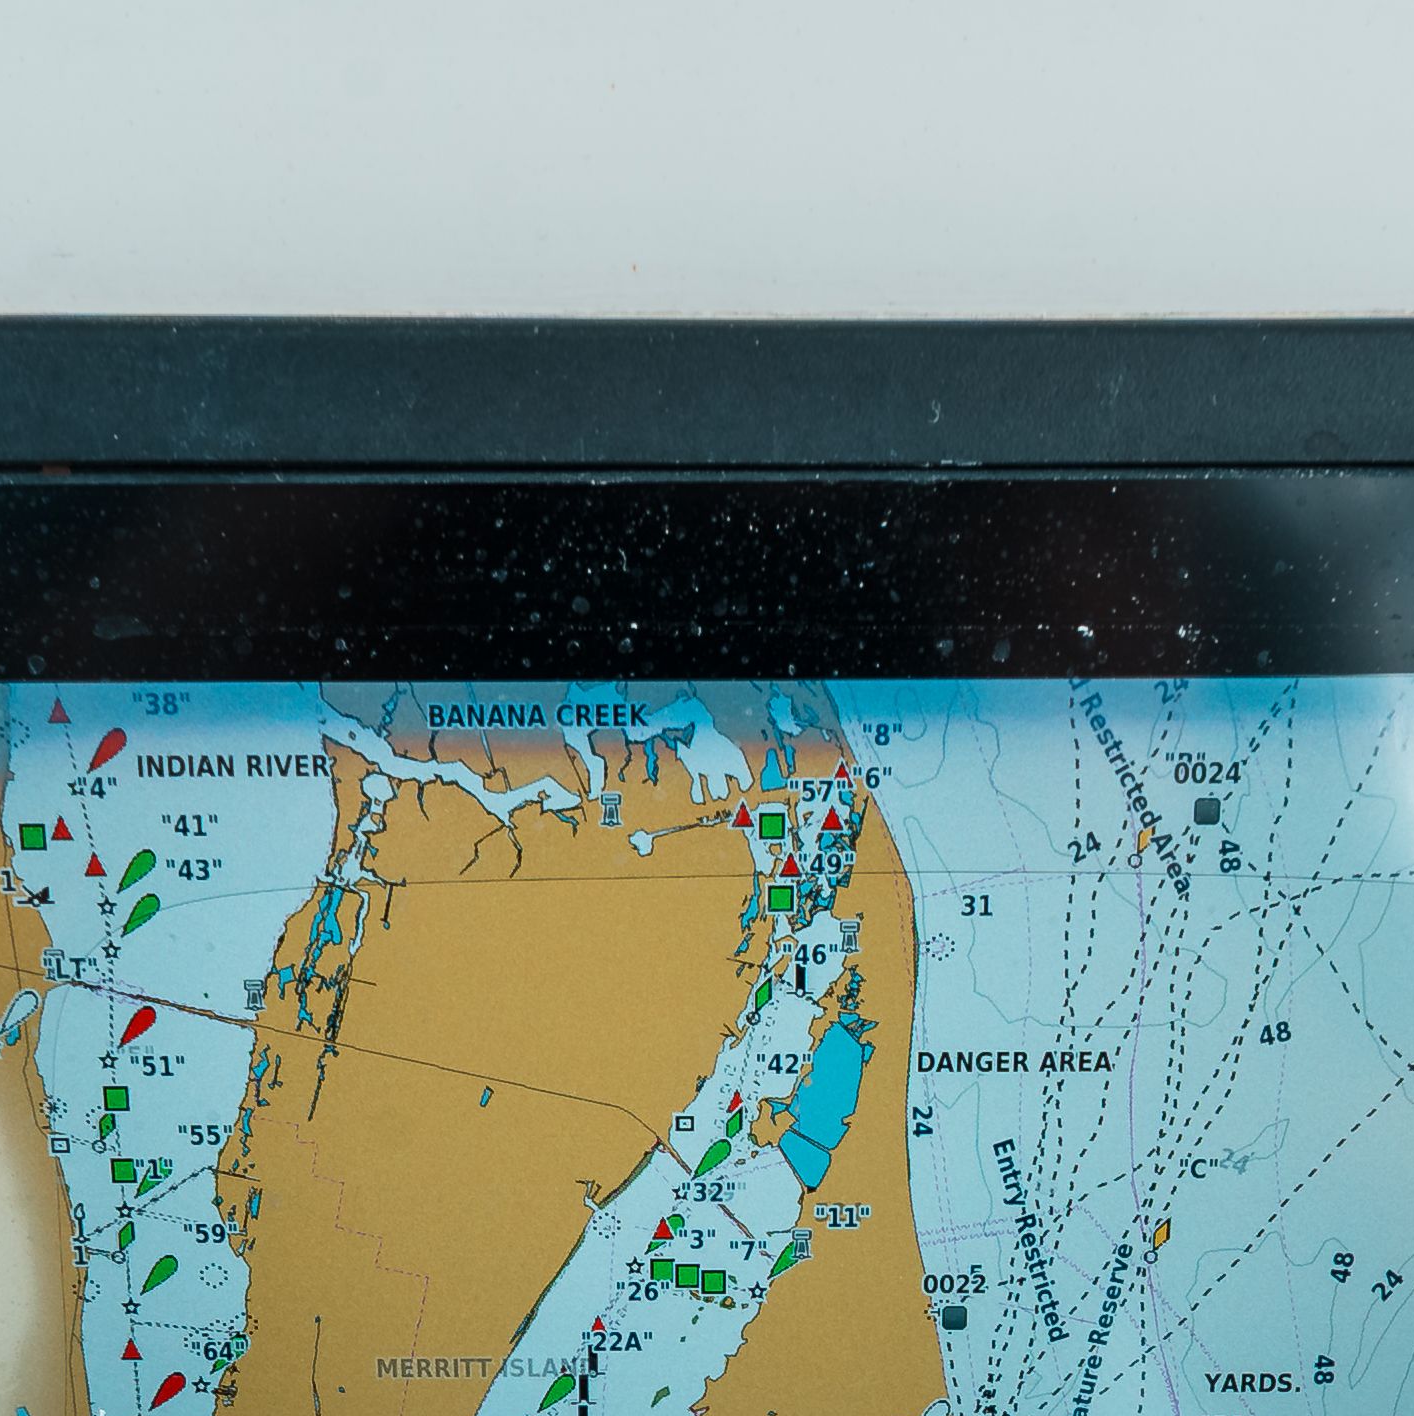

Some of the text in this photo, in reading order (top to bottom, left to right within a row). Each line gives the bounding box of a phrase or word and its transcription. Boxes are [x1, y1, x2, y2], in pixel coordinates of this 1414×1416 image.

[132, 692, 190, 715] "38"
[429, 704, 647, 728] BANANA CREEK
[863, 724, 902, 745] "8"
[137, 755, 330, 777] INDIAN RIVER
[1174, 762, 1241, 784] 0024
[853, 767, 892, 788] "6"
[790, 780, 846, 802] "57"
[1080, 692, 1161, 829] Restricted
[1151, 833, 1190, 894] Area
[162, 815, 218, 837] "41"
[1068, 833, 1101, 862] 24
[1219, 840, 1241, 874] 48
[166, 859, 222, 881] "43"
[798, 852, 854, 875] "49"
[961, 896, 993, 916] 31
[782, 945, 838, 965] "46"
[1259, 1022, 1291, 1045] 48
[130, 1056, 185, 1076] "51"
[757, 1054, 812, 1074] "42"
[917, 1052, 1112, 1072] DANGER AREA
[913, 1106, 933, 1137] 24
[178, 1125, 232, 1145] "55"
[1180, 1159, 1218, 1178] "C"
[816, 1207, 869, 1227] "11"
[184, 1224, 237, 1243] "59"
[679, 1230, 715, 1249] "3"
[993, 1138, 1069, 1343] Entry Restricted
[730, 1241, 766, 1260] "7"
[1331, 1252, 1354, 1283] 48
[617, 1282, 669, 1300] "26"
[924, 1274, 986, 1293] 0022
[1371, 1270, 1404, 1301] 24
[1088, 1243, 1133, 1347] Reserve
[582, 1331, 652, 1350] "22A"
[192, 1342, 246, 1361] "64"
[377, 1358, 491, 1378] MERRITT
[1314, 1355, 1335, 1384] 48
[1204, 1373, 1301, 1393] YARDS.
